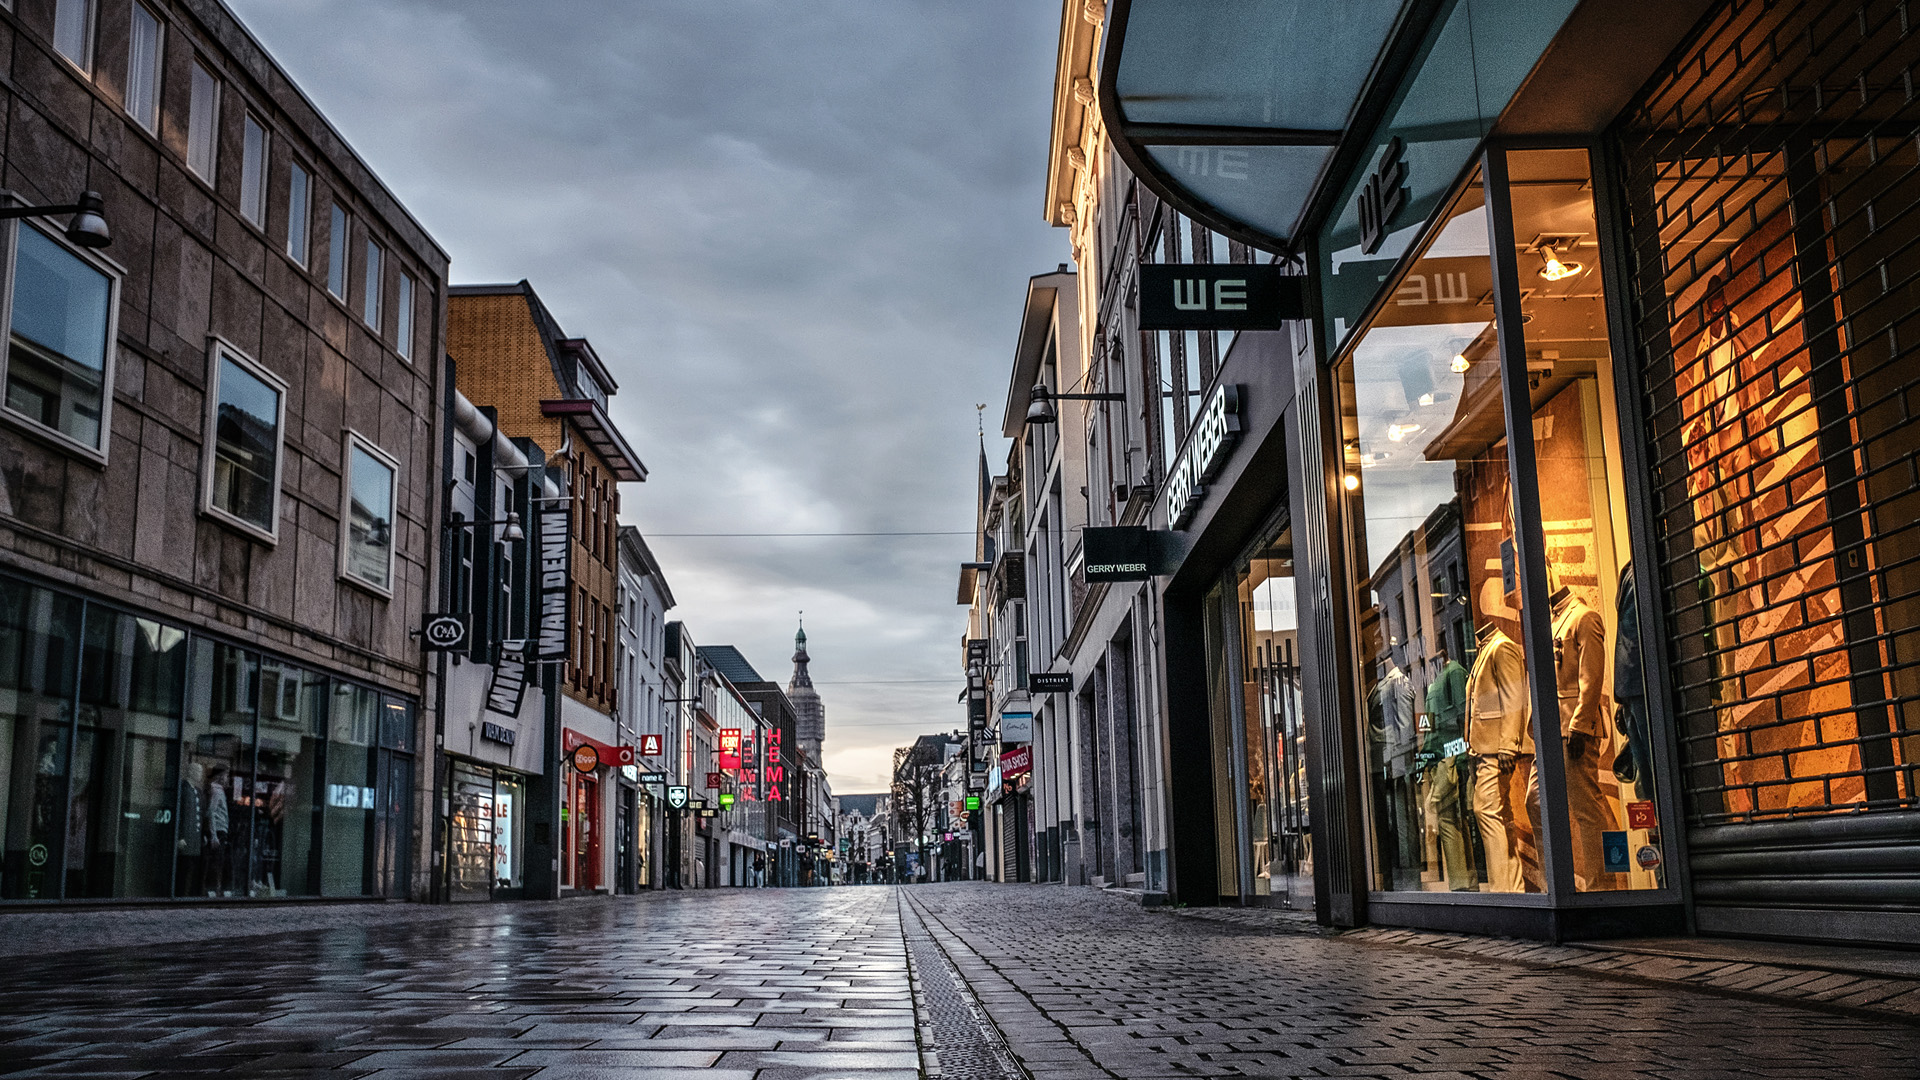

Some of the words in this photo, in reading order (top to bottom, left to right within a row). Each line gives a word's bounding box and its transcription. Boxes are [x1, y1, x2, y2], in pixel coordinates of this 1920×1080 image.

[1174, 279, 1247, 310] WE
[1167, 446, 1192, 531] GERRY
[1191, 384, 1228, 486] WEBER
[541, 513, 567, 589] DENIM
[1087, 564, 1115, 573] GERRY
[1116, 563, 1146, 572] WEBER
[433, 625, 458, 638] C&A
[539, 593, 566, 656] WAM
[766, 728, 783, 801] HEMA
[1012, 752, 1028, 769] SHOES
[483, 803, 507, 818] SLE
